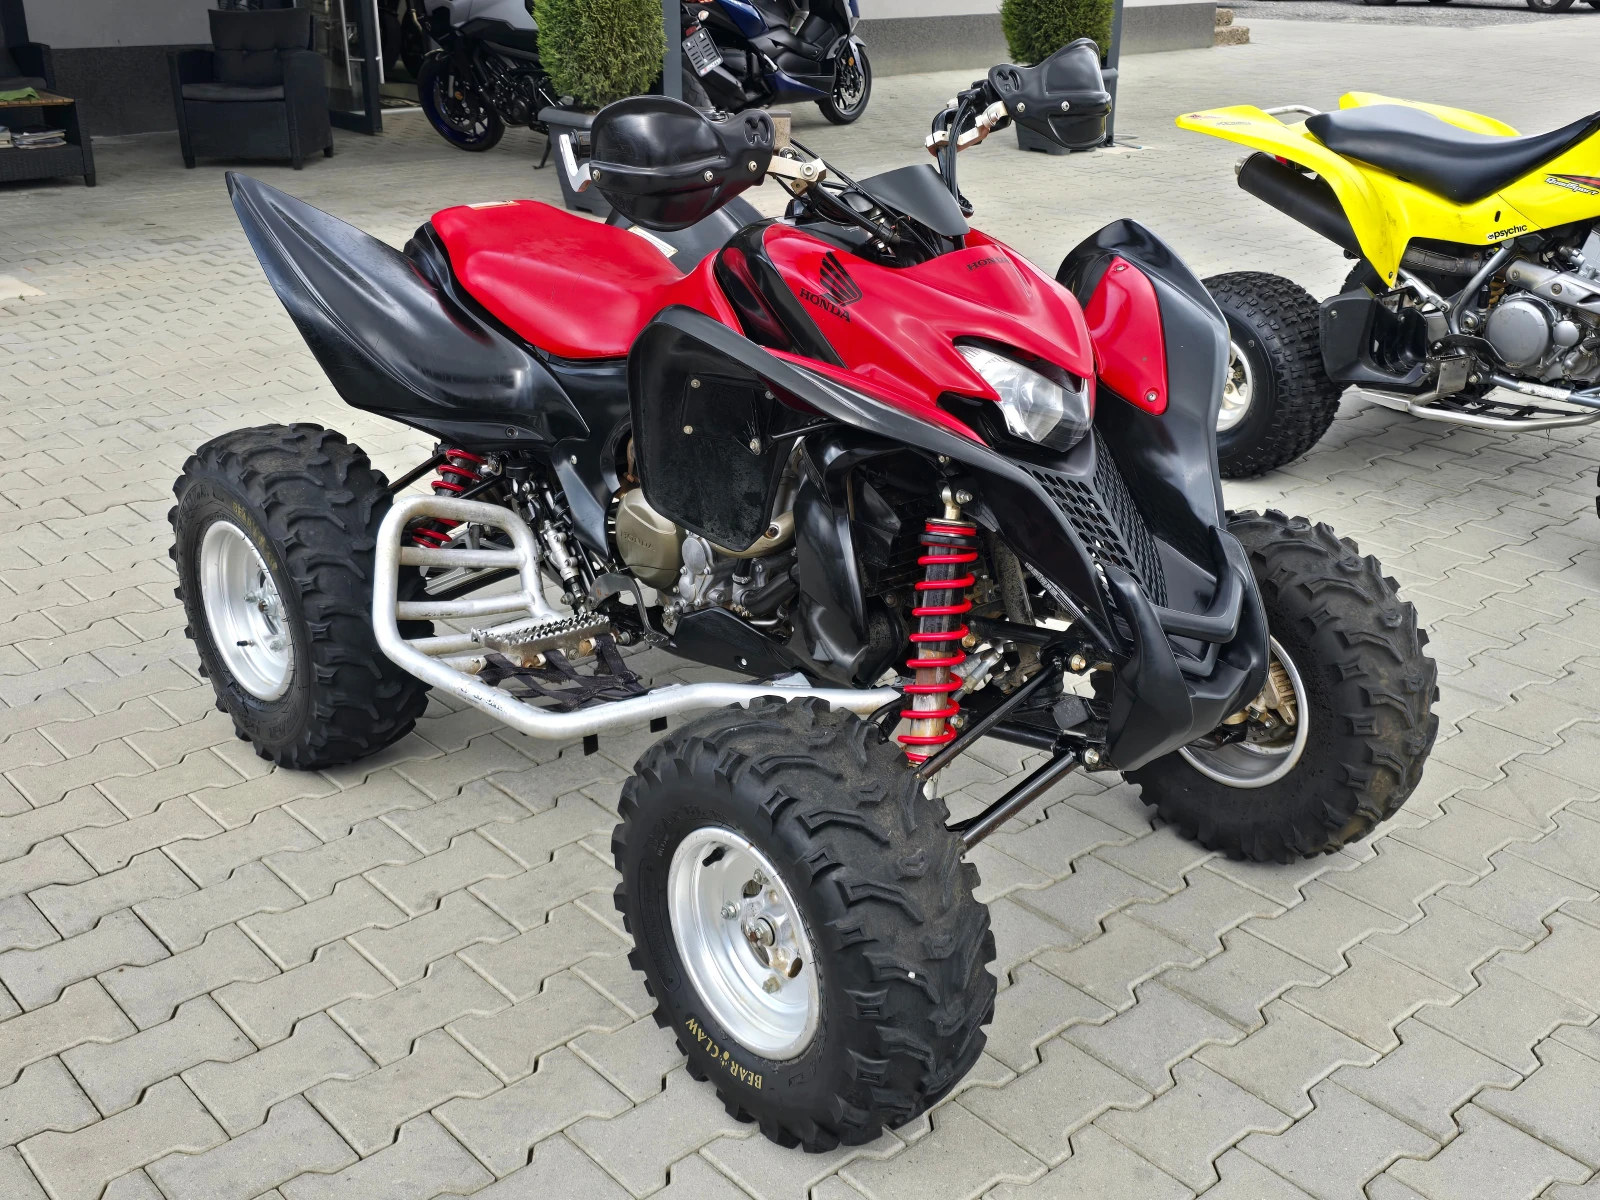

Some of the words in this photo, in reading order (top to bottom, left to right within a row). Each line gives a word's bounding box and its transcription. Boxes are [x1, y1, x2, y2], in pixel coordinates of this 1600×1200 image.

[1544, 176, 1600, 196] QuadSport
[1494, 224, 1527, 239] psychic
[967, 257, 1009, 271] HONDA
[800, 287, 851, 322] HONDA
[685, 1018, 720, 1058] CLAW
[729, 1060, 763, 1089] BEAR
